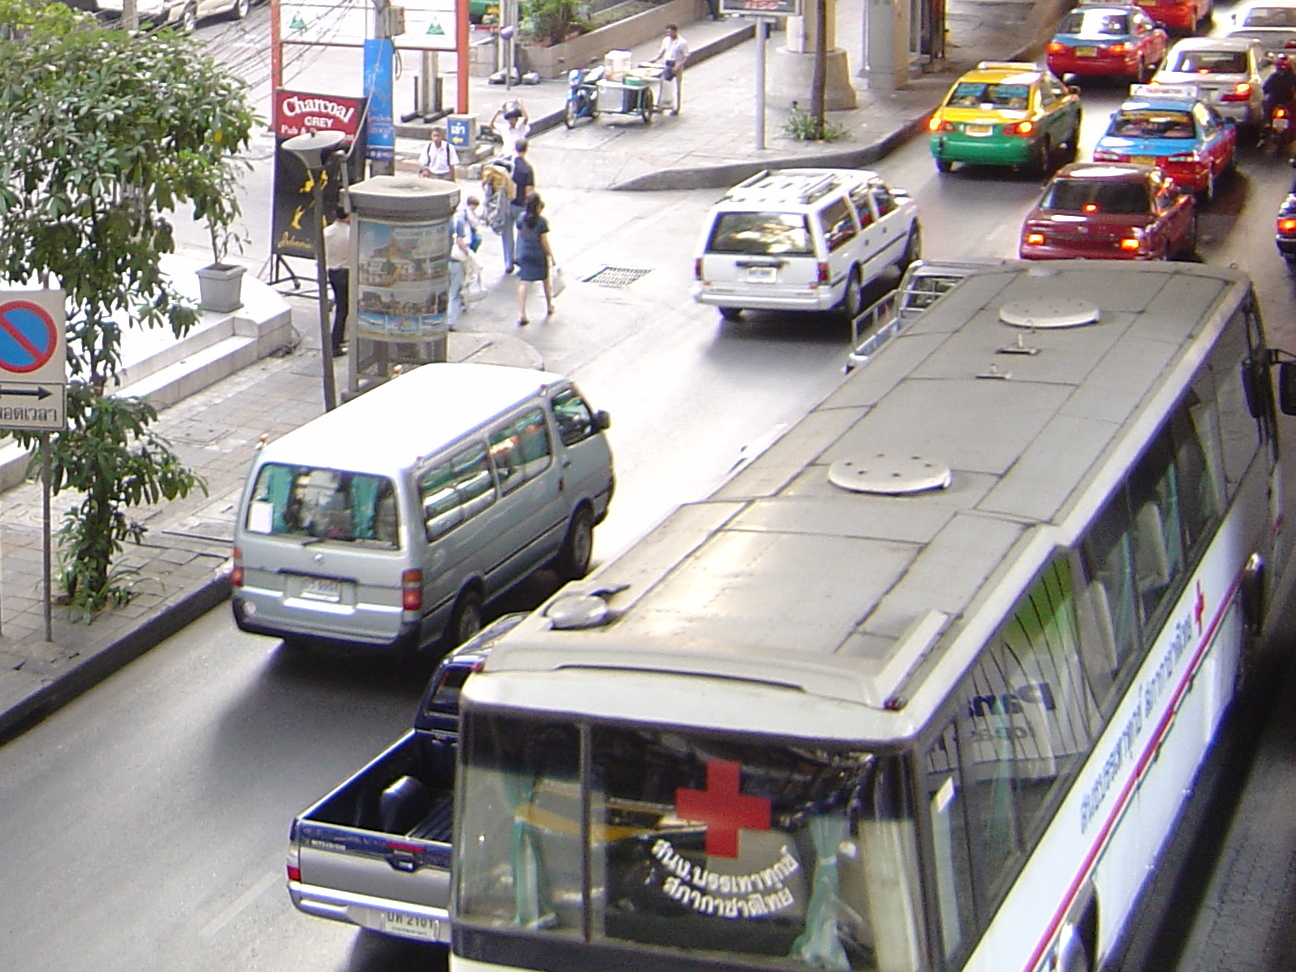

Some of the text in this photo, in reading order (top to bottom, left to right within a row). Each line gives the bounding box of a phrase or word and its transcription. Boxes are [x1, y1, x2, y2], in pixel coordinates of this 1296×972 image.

[282, 96, 354, 123] Charcoal
[280, 125, 299, 135] Pub
[304, 116, 334, 128] GREY
[662, 876, 794, 918] สภากาชาดไทย
